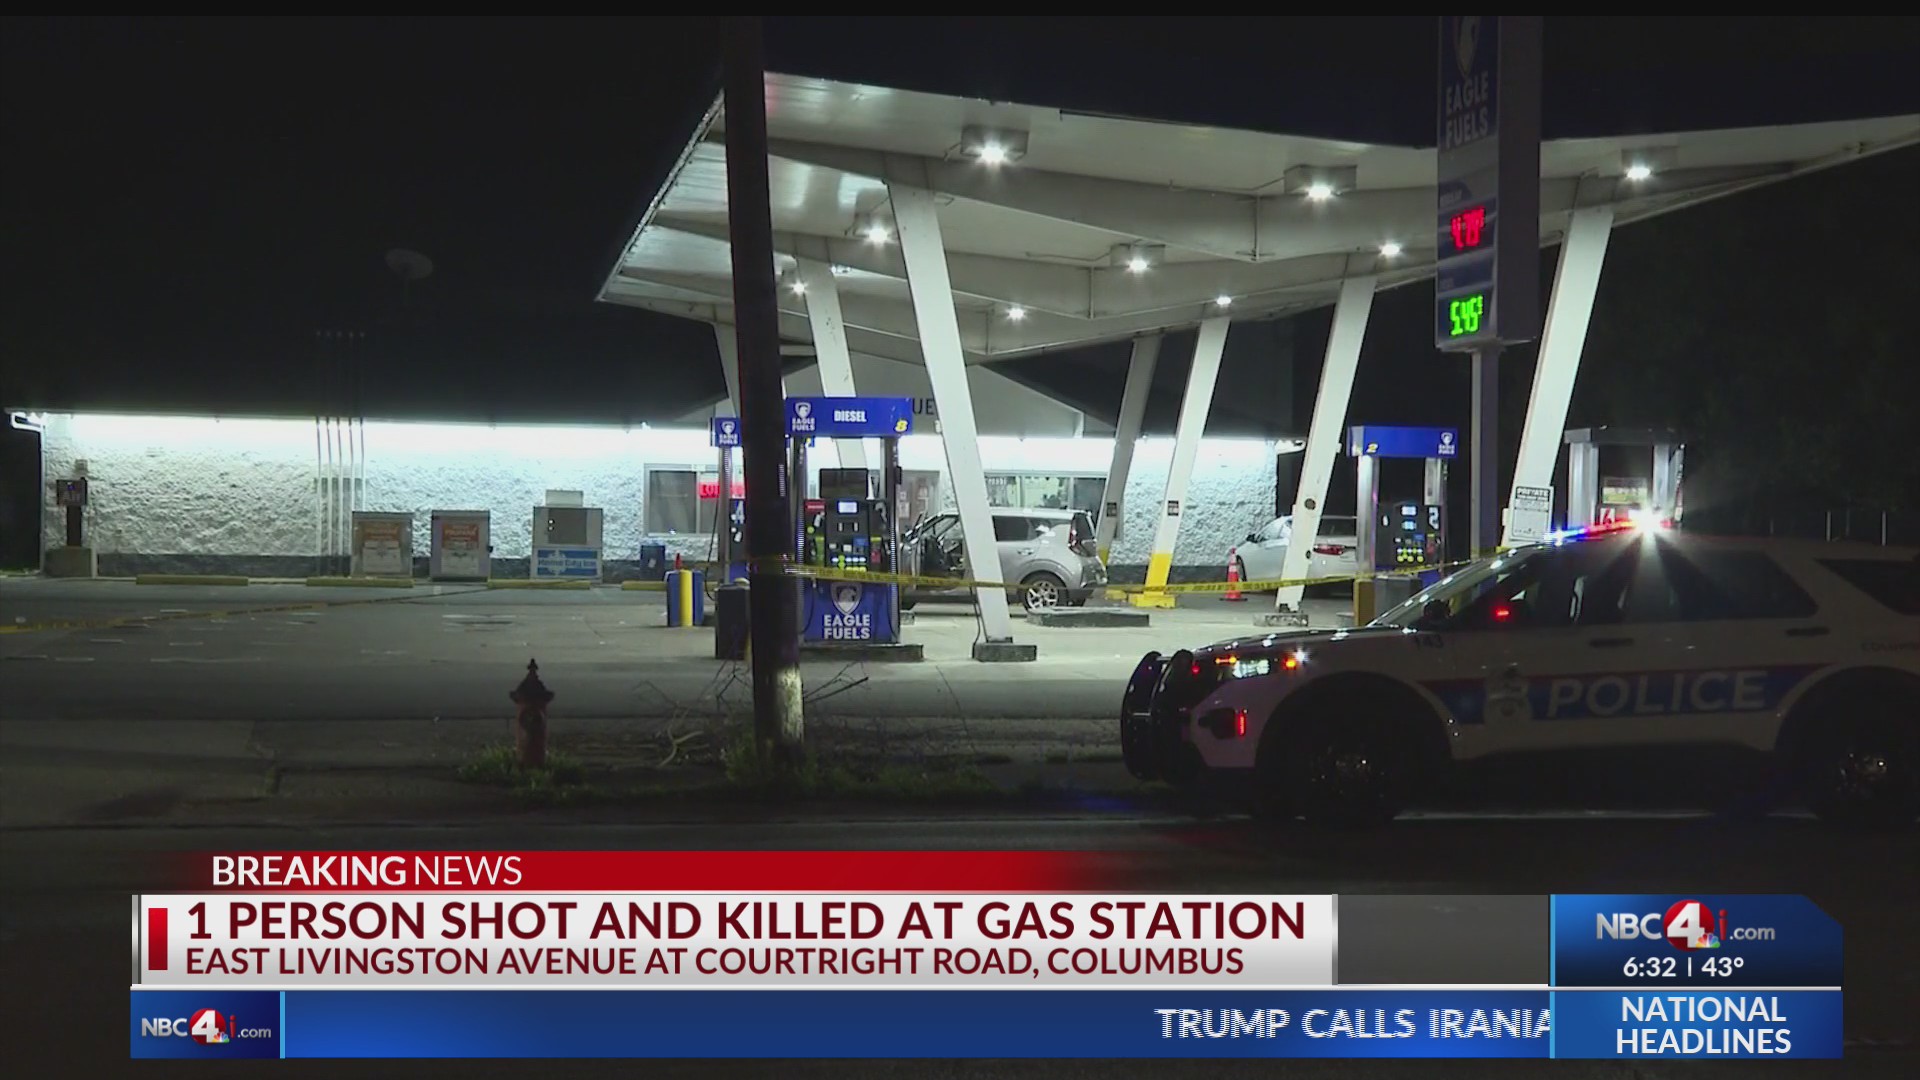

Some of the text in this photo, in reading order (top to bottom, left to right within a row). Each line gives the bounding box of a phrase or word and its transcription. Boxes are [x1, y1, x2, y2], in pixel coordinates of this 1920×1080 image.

[1446, 71, 1488, 115] EAGLE
[1446, 106, 1488, 149] FUELS
[834, 411, 867, 423] DIESEL
[895, 420, 908, 432] 8
[1366, 443, 1378, 453] 2
[823, 614, 871, 627] EAGLE
[823, 627, 871, 640] FUELS
[1546, 670, 1769, 718] POLICE
